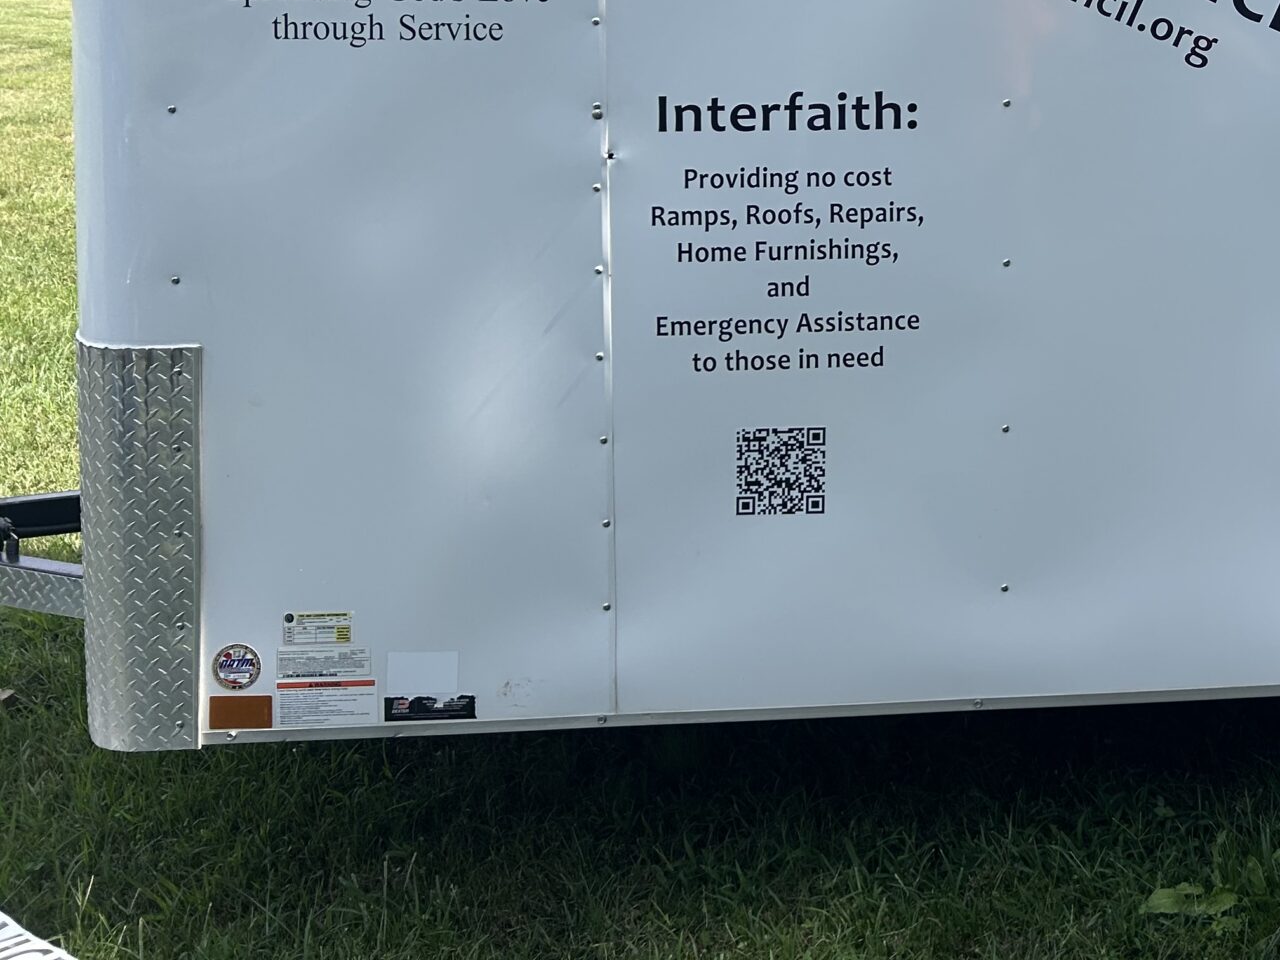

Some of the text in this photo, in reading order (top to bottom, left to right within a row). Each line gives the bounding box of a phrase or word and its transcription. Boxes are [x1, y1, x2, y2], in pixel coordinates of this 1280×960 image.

[272, 13, 504, 48] through Service
[657, 90, 919, 133] Interfaith:
[684, 167, 893, 195] Providing no cost
[651, 201, 924, 232] Ramps, Roofs, Repairs,
[677, 238, 899, 266] Home Furnishings,
[767, 274, 810, 297] and
[656, 310, 920, 342] Emergency Assistance
[692, 345, 884, 373] to those in need
